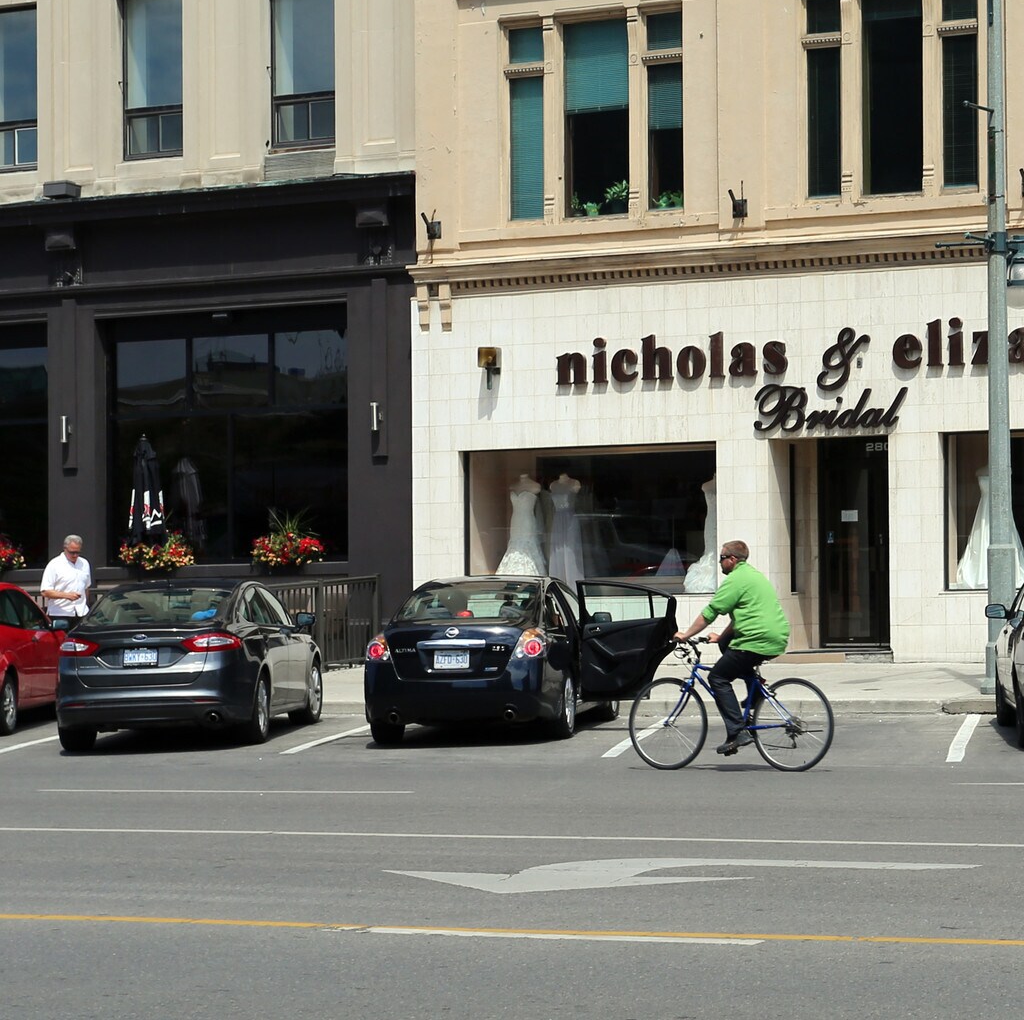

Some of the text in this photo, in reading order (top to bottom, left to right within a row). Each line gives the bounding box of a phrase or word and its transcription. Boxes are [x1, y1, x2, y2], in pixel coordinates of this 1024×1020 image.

[555, 331, 789, 388] nicholas
[817, 327, 871, 393] &
[754, 382, 908, 433] Bridal
